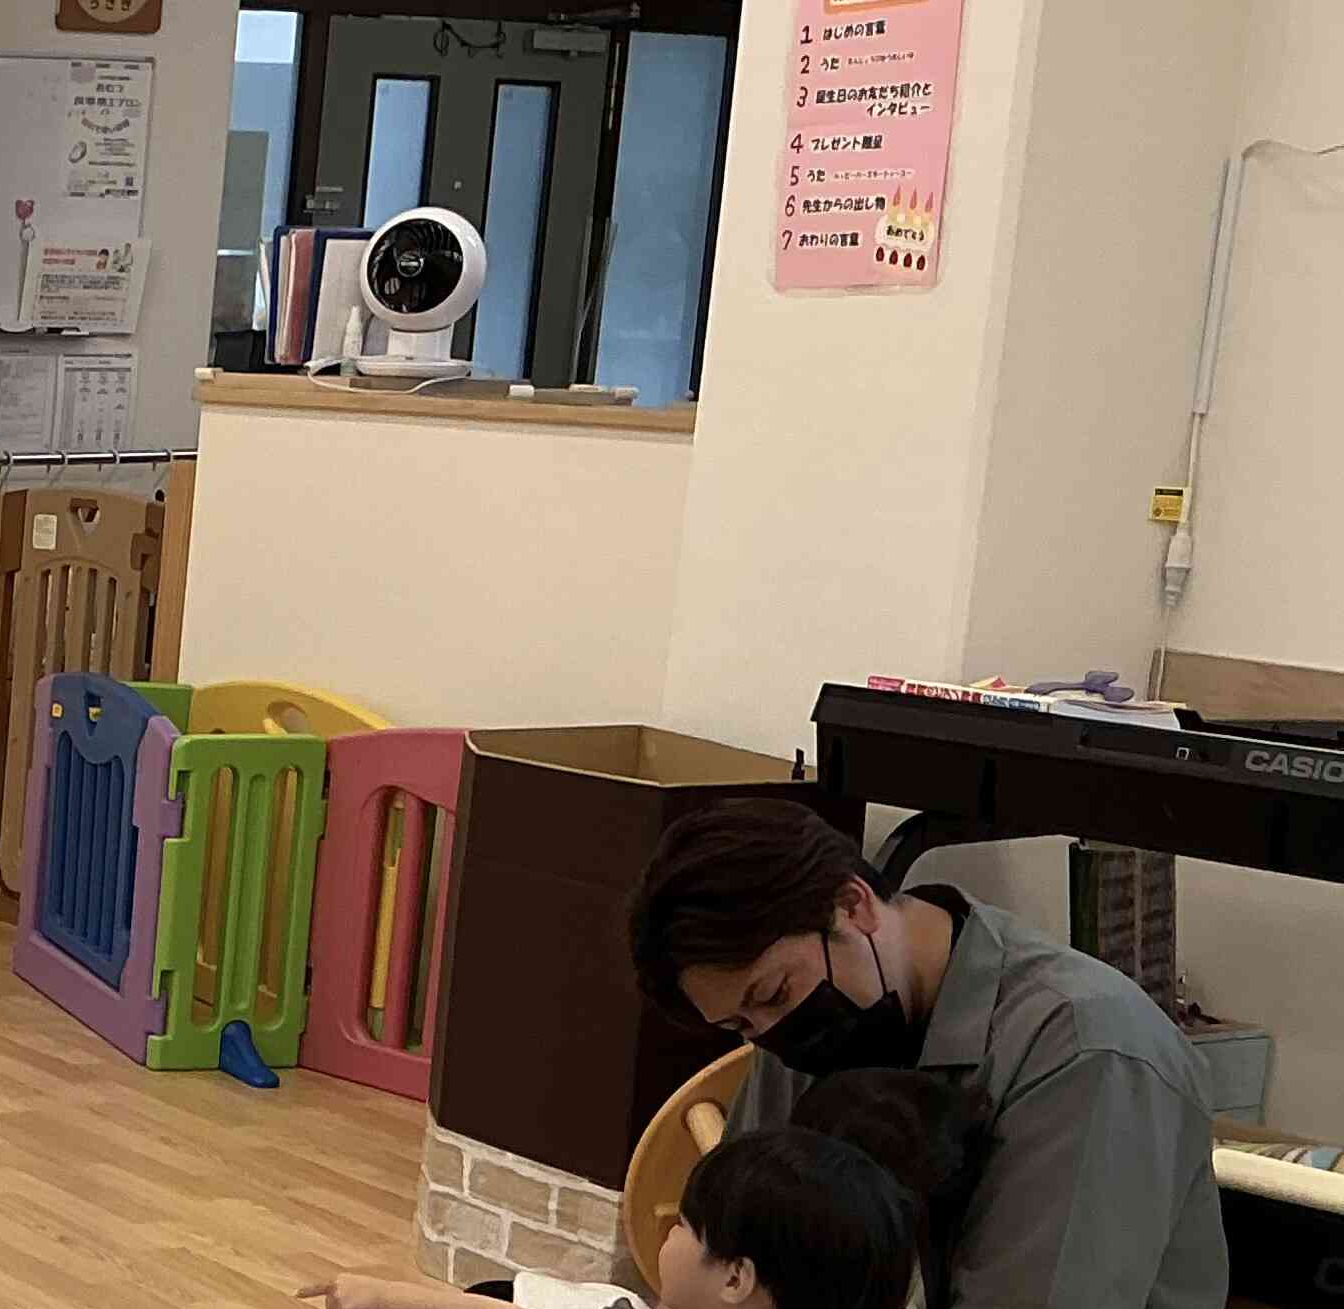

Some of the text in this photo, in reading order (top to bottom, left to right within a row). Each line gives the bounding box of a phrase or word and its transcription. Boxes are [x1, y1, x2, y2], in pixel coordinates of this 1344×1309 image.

[800, 19, 885, 44] 1 はじめの言葉
[800, 55, 840, 74] 2 うた
[796, 86, 808, 108] 3
[866, 102, 930, 117] インタビュー
[790, 133, 804, 153] 4
[790, 165, 800, 186] 5
[807, 169, 825, 182] うた
[785, 195, 886, 217] 6 先生からの出し物
[781, 230, 859, 250] 7 おわりの言葉
[1245, 750, 1344, 782] CASIO
